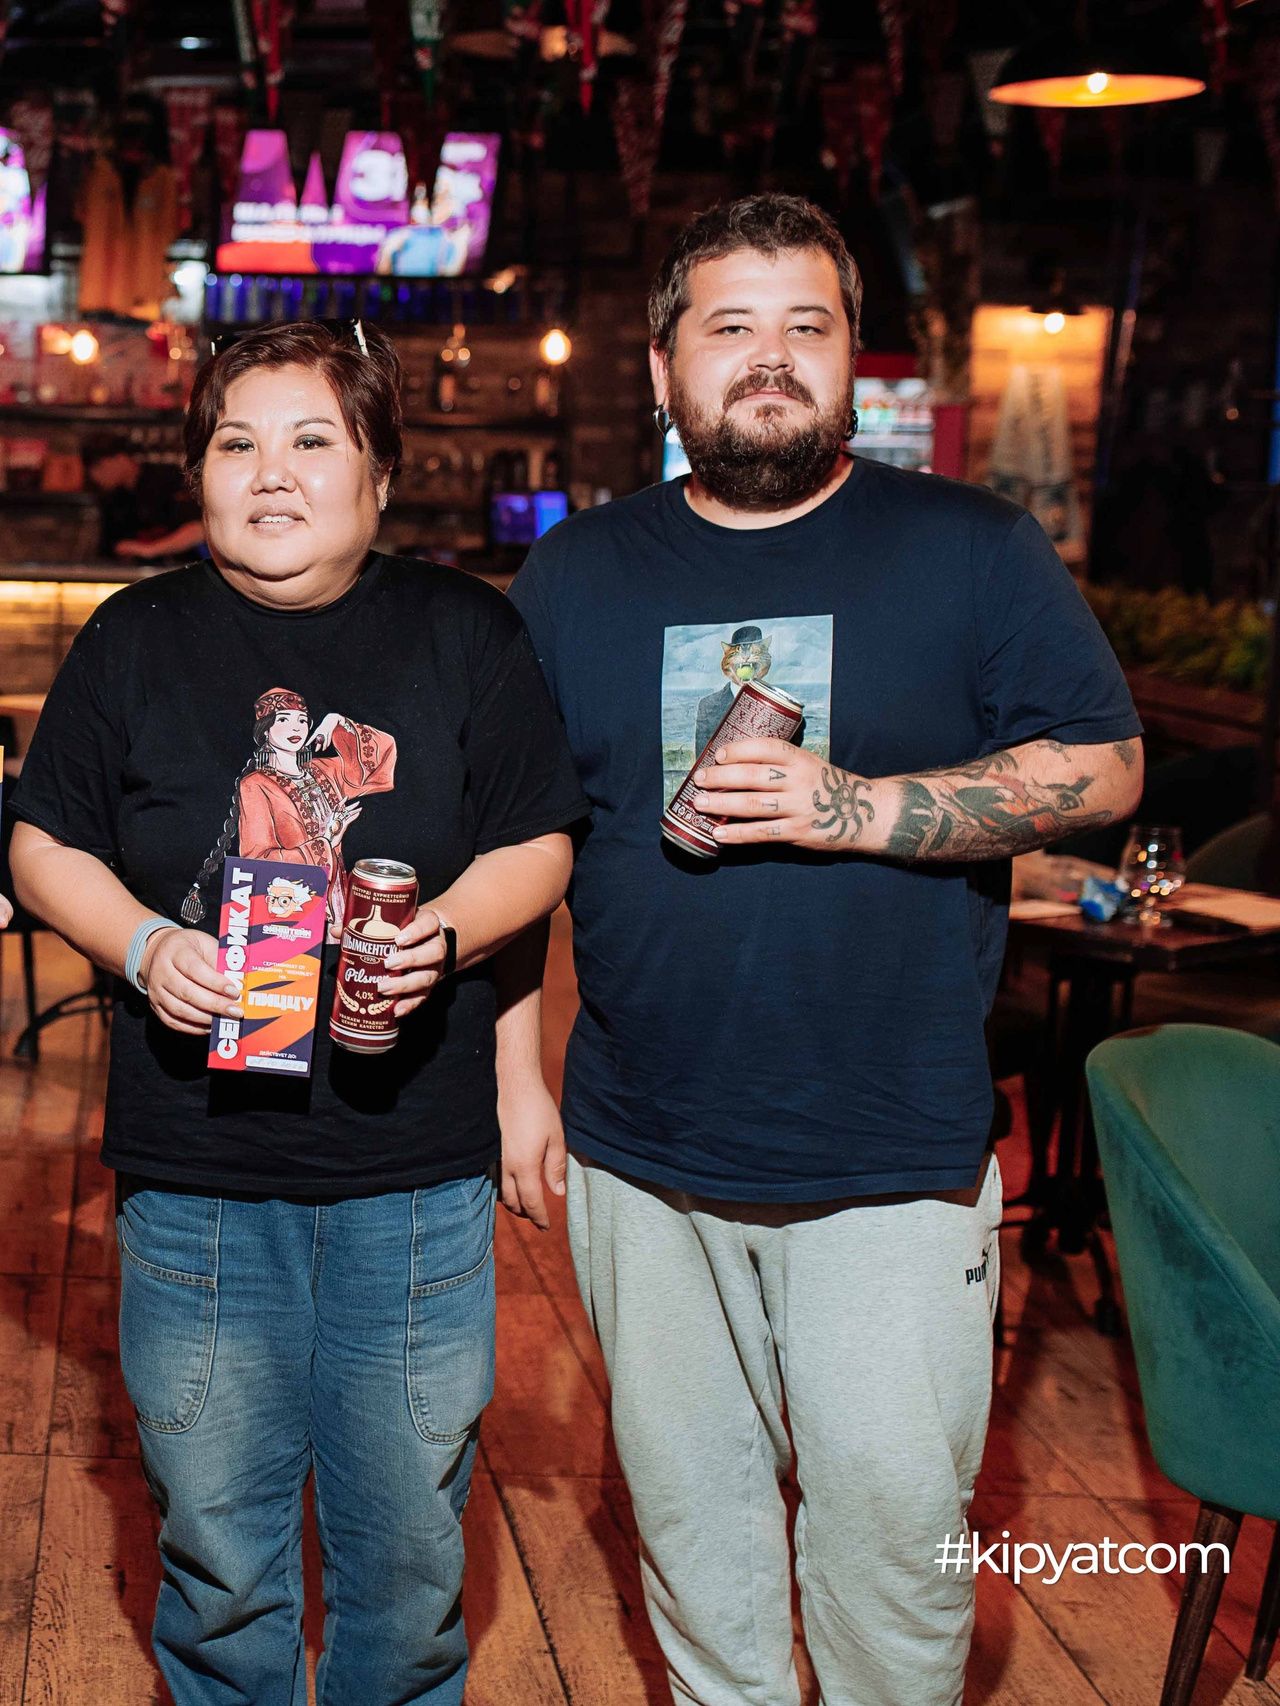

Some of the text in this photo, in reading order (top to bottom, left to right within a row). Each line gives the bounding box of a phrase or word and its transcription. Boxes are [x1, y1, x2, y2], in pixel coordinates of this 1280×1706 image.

[342, 931, 398, 957] ШЫМКЕНТСК
[216, 867, 254, 1060] СЕИФИКАТ
[247, 991, 314, 1012] ПИЦЦУ
[354, 990, 374, 1001] 4,0%
